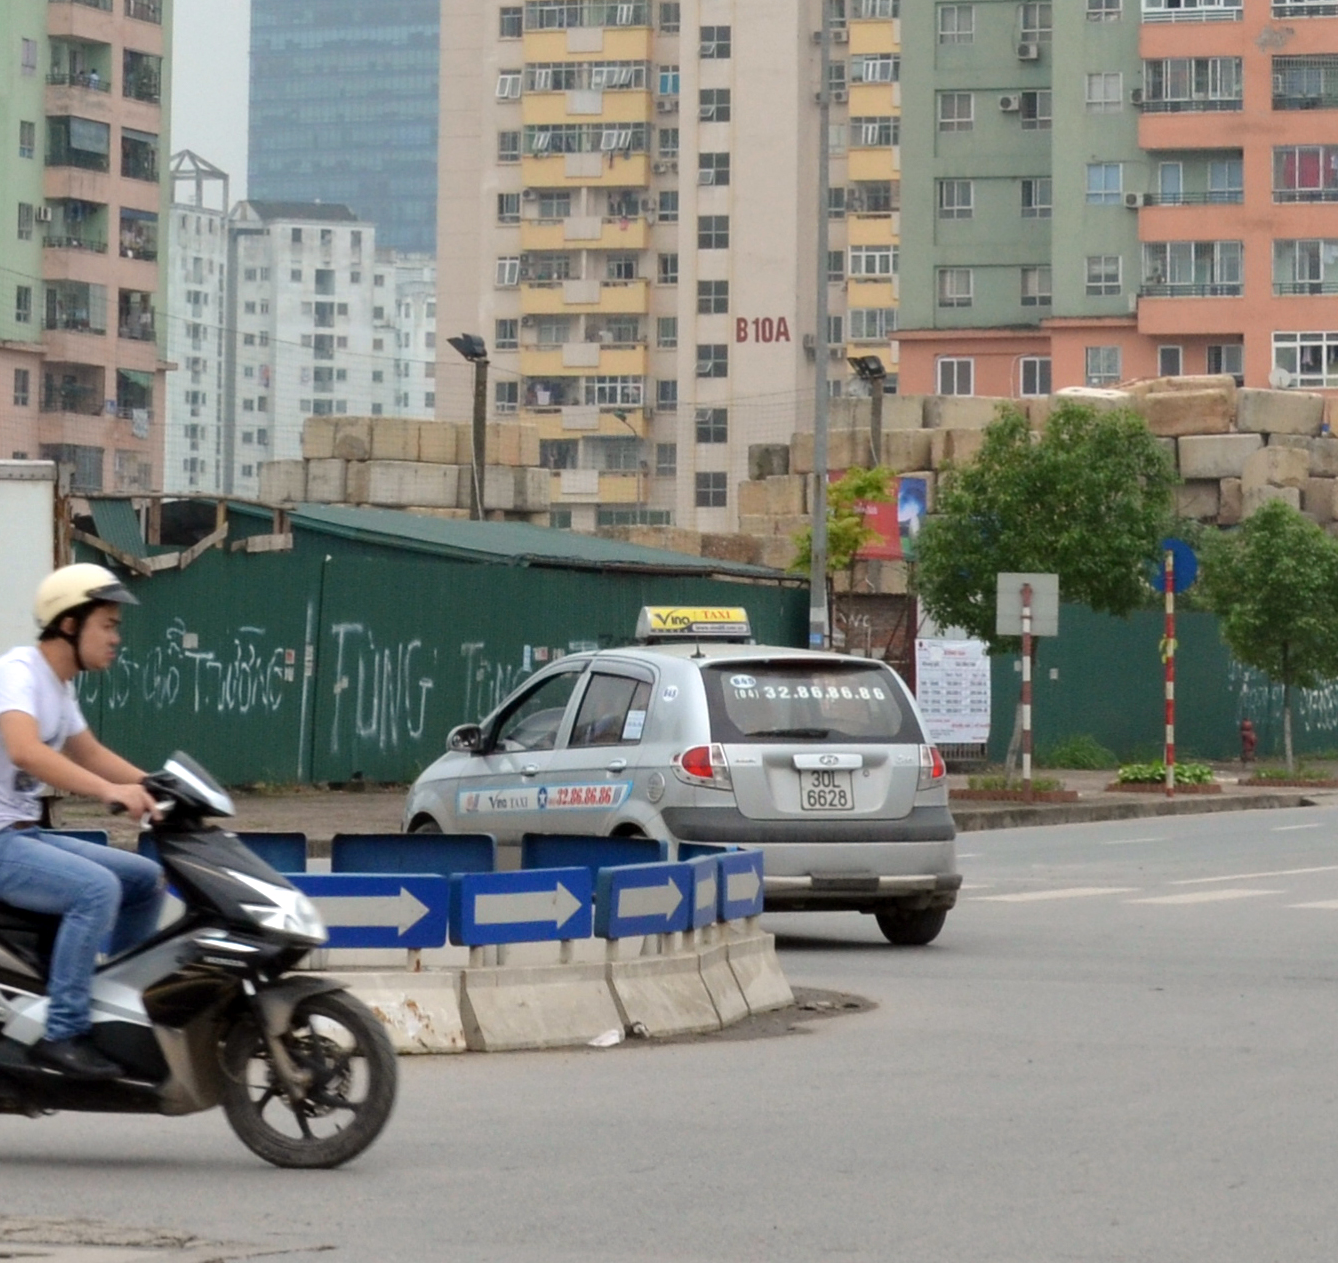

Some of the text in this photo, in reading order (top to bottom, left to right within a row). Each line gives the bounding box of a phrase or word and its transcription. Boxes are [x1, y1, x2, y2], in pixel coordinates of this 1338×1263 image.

[702, 610, 731, 619] TAXI
[807, 770, 847, 807] 30L 6628
